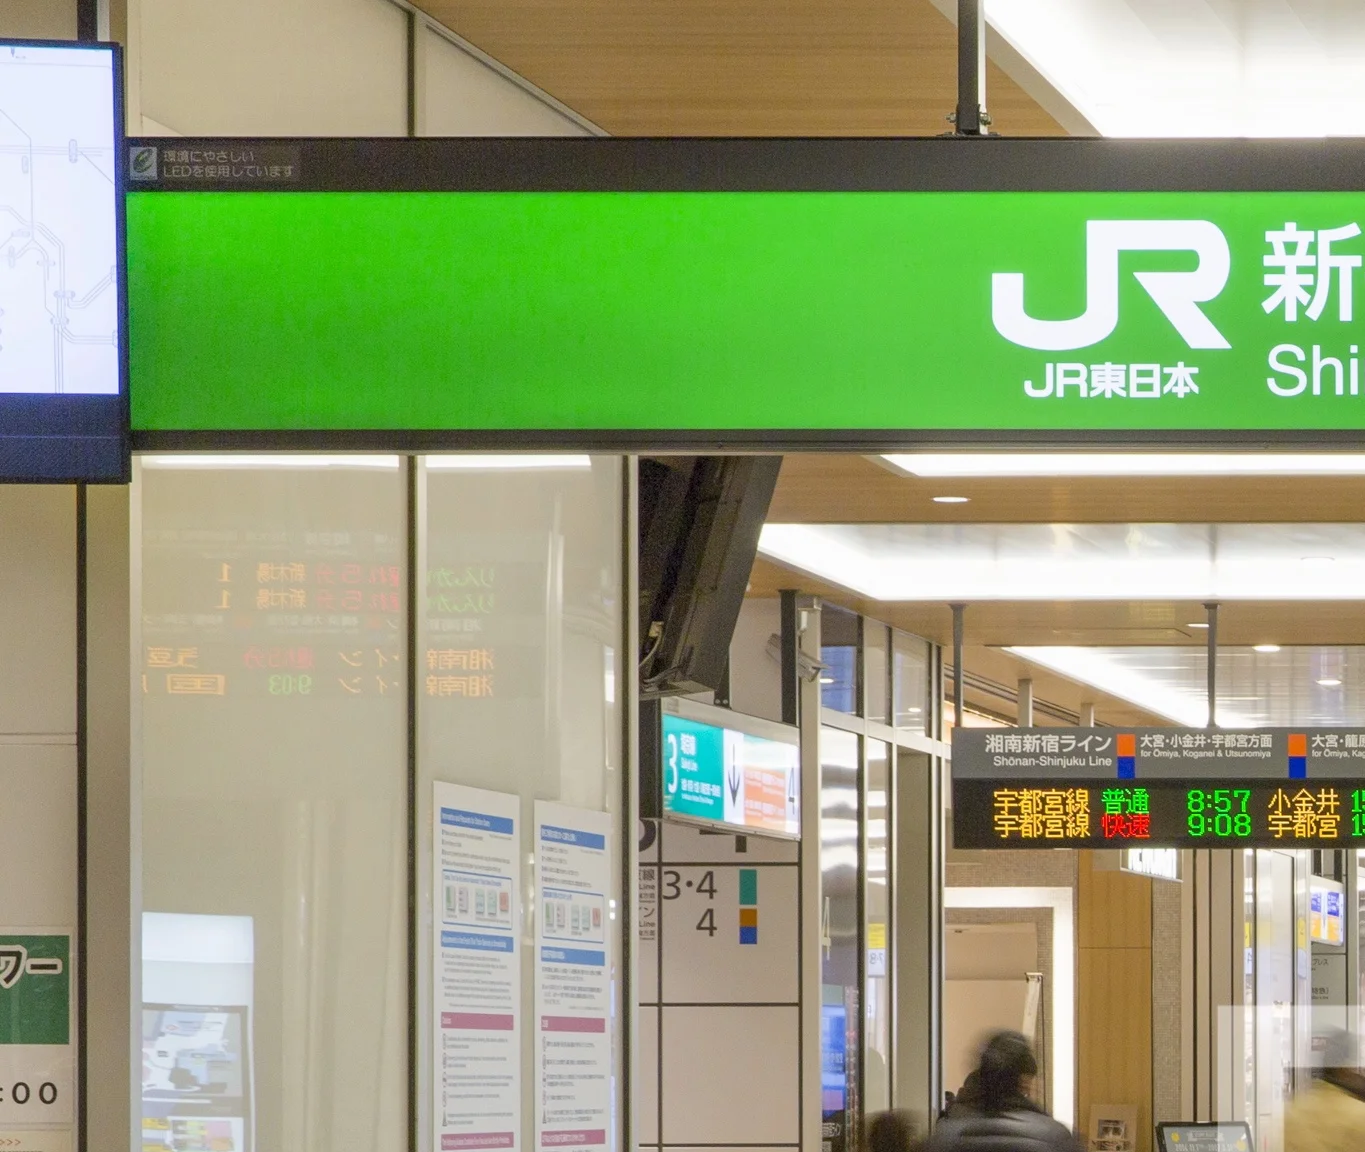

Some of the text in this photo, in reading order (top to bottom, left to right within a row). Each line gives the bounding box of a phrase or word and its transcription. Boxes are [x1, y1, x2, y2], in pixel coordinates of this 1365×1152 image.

[163, 151, 254, 162] 環境にやさしい
[163, 165, 293, 178] LEDを使用しています
[992, 219, 1232, 350] JR
[1023, 362, 1200, 399] JR東日本
[986, 735, 1112, 752] 湘南新宿ライン
[1140, 734, 1272, 748] 大宮・小金井・宇都宮方面
[1088, 755, 1112, 766] Line
[1225, 749, 1272, 759] Utsunomiya
[993, 789, 1090, 814] 宇都宮線
[1101, 789, 1150, 814] 普通
[1187, 789, 1251, 812] 8:57
[1268, 789, 1340, 814] 小金井
[993, 813, 1090, 838] 宇都宮線
[1101, 813, 1150, 838] 快速
[1187, 814, 1251, 836] 9:08
[1268, 813, 1340, 838] 宇都宮
[696, 908, 717, 937] 4
